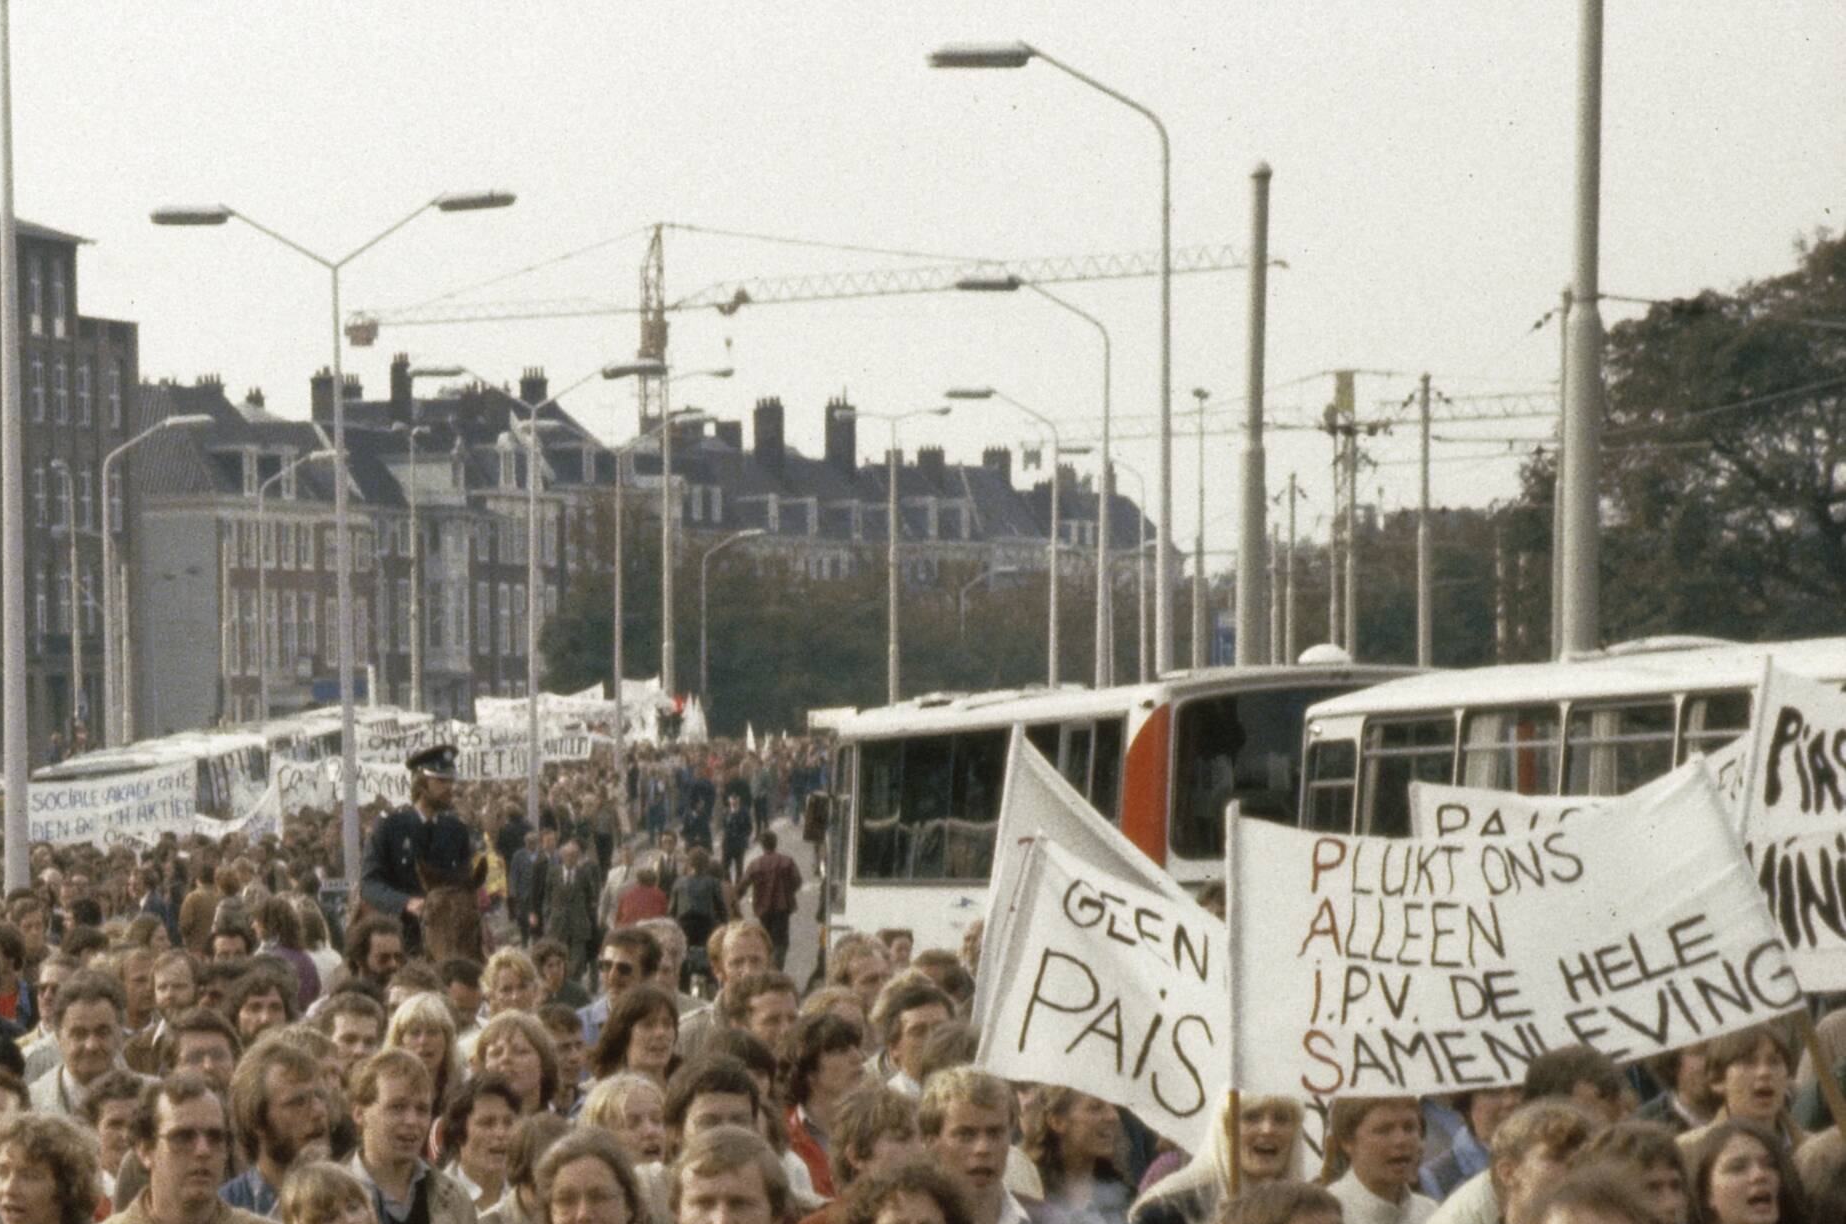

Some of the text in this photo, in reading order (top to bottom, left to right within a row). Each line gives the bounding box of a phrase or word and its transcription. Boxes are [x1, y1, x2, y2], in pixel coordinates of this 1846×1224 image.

[1311, 832, 1584, 896] PLUKT ONS
[1062, 878, 1209, 983] GEEN
[1297, 897, 1505, 968] ALLEEN
[1450, 970, 1533, 1022] DE
[1558, 913, 1720, 1003] HELE
